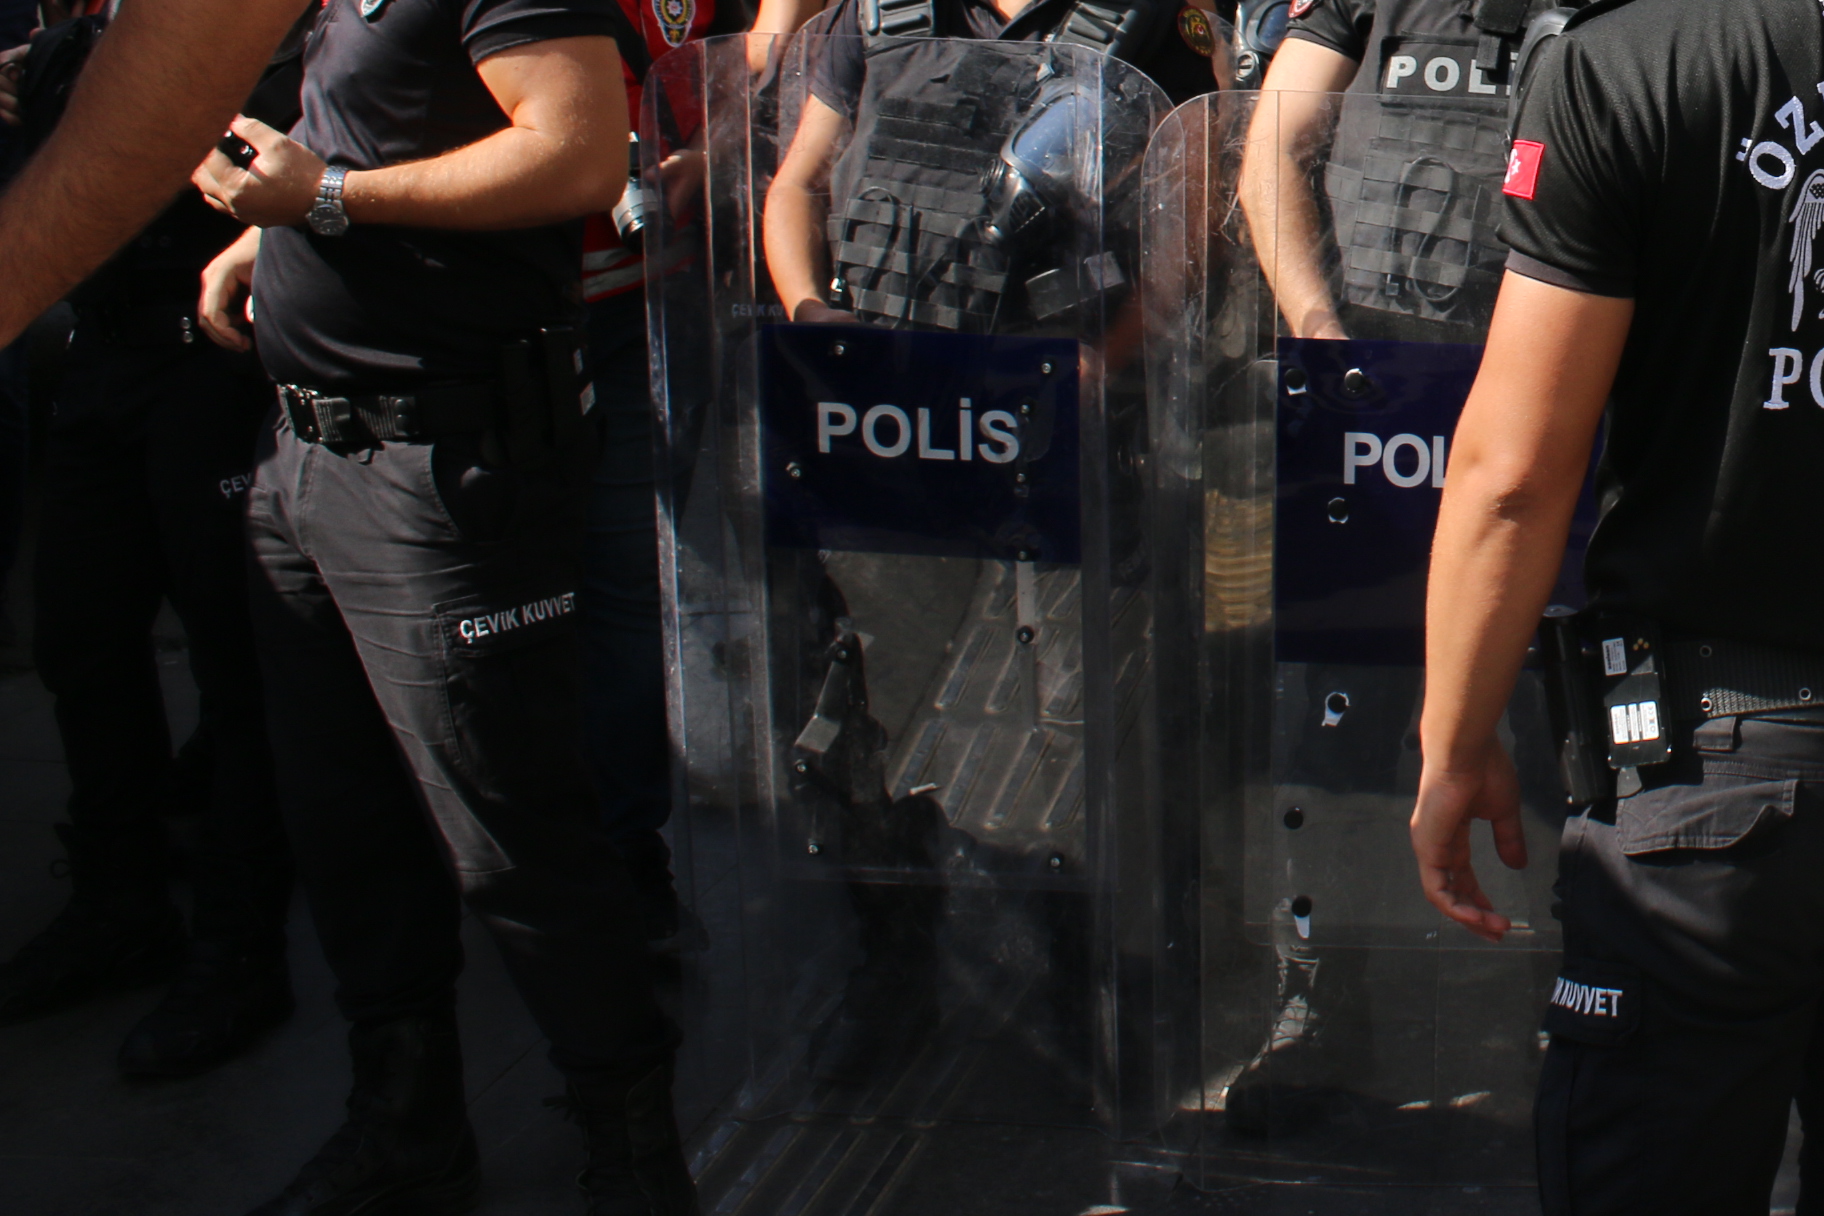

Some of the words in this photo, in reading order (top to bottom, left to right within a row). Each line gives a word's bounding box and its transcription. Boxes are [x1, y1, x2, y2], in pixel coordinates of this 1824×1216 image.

[1385, 54, 1512, 96] POL
[816, 396, 1021, 465] POLİS
[1343, 431, 1447, 489] POL
